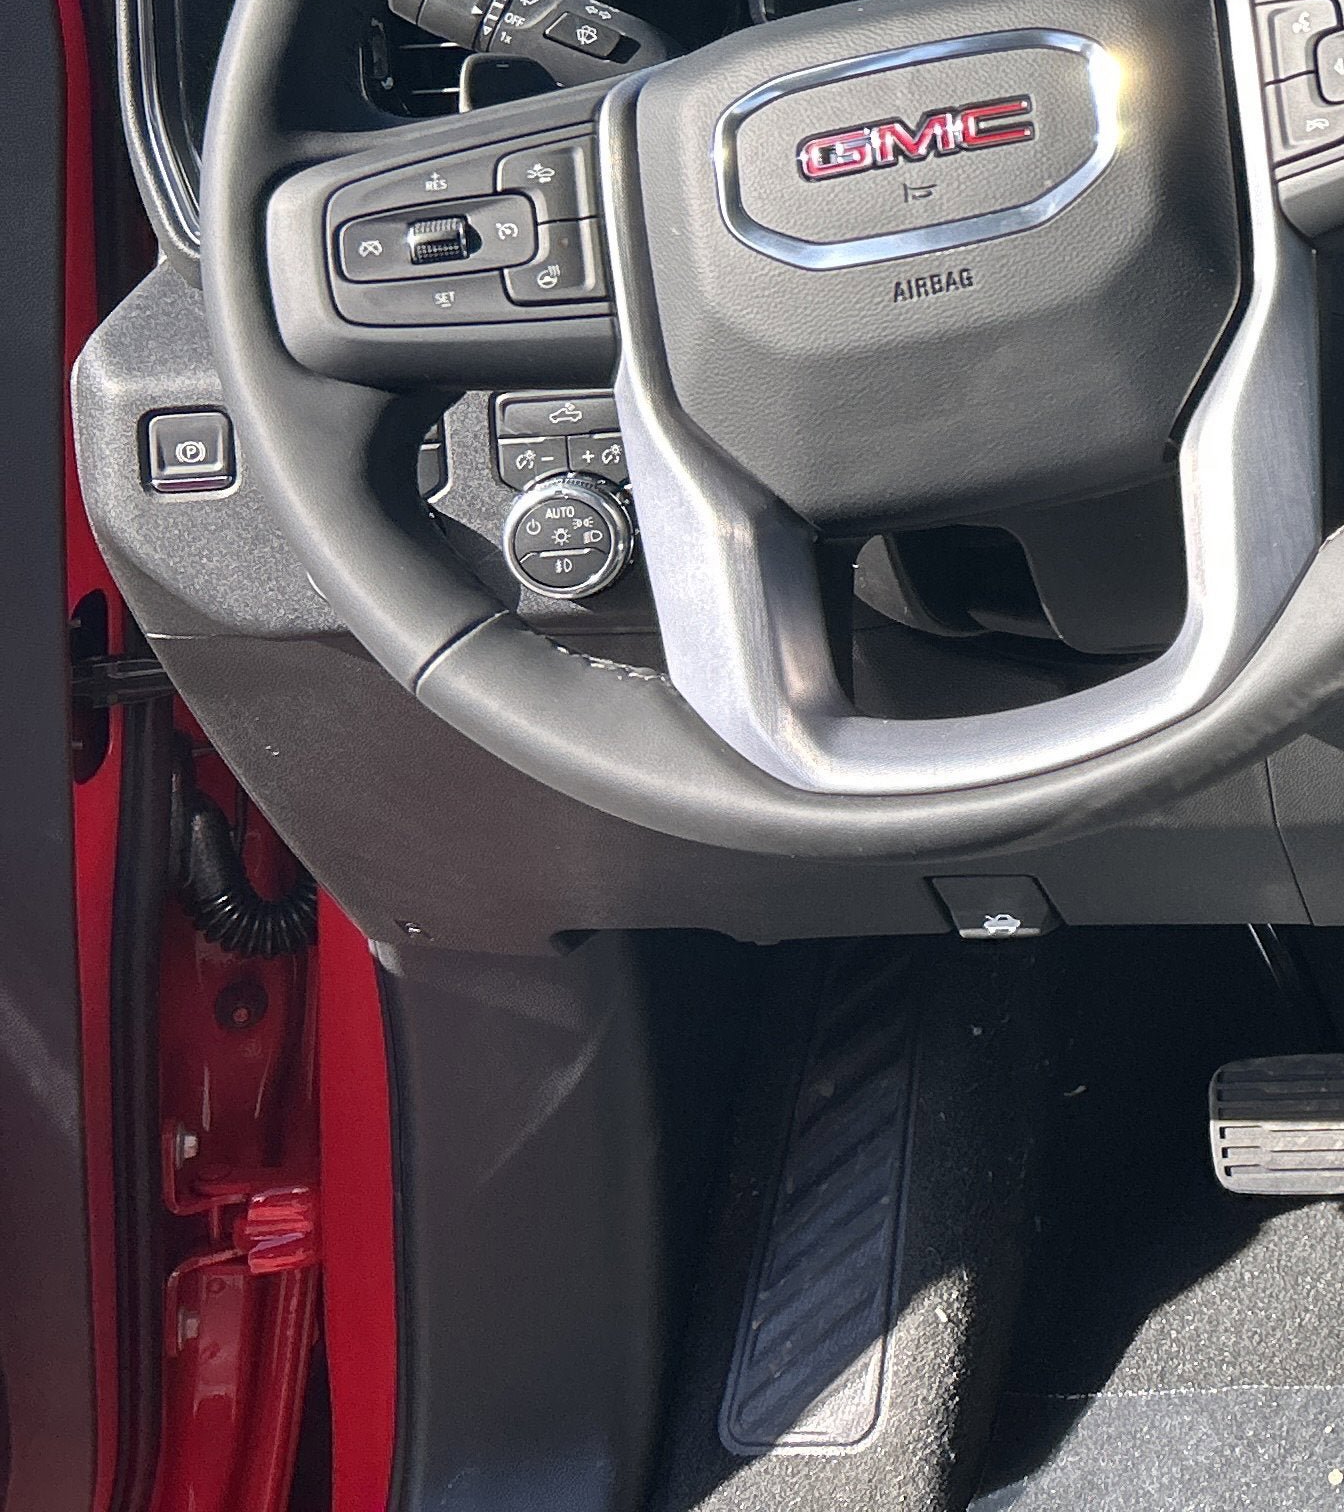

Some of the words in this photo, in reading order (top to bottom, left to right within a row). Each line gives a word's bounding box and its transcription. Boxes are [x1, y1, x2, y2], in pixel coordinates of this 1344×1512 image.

[503, 12, 526, 27] OFF
[500, 31, 513, 44] 1x
[797, 93, 1036, 184] GMC
[425, 178, 448, 192] RES
[893, 268, 974, 303] AIRBAG
[435, 292, 456, 305] SET
[545, 506, 575, 519] AUTO
